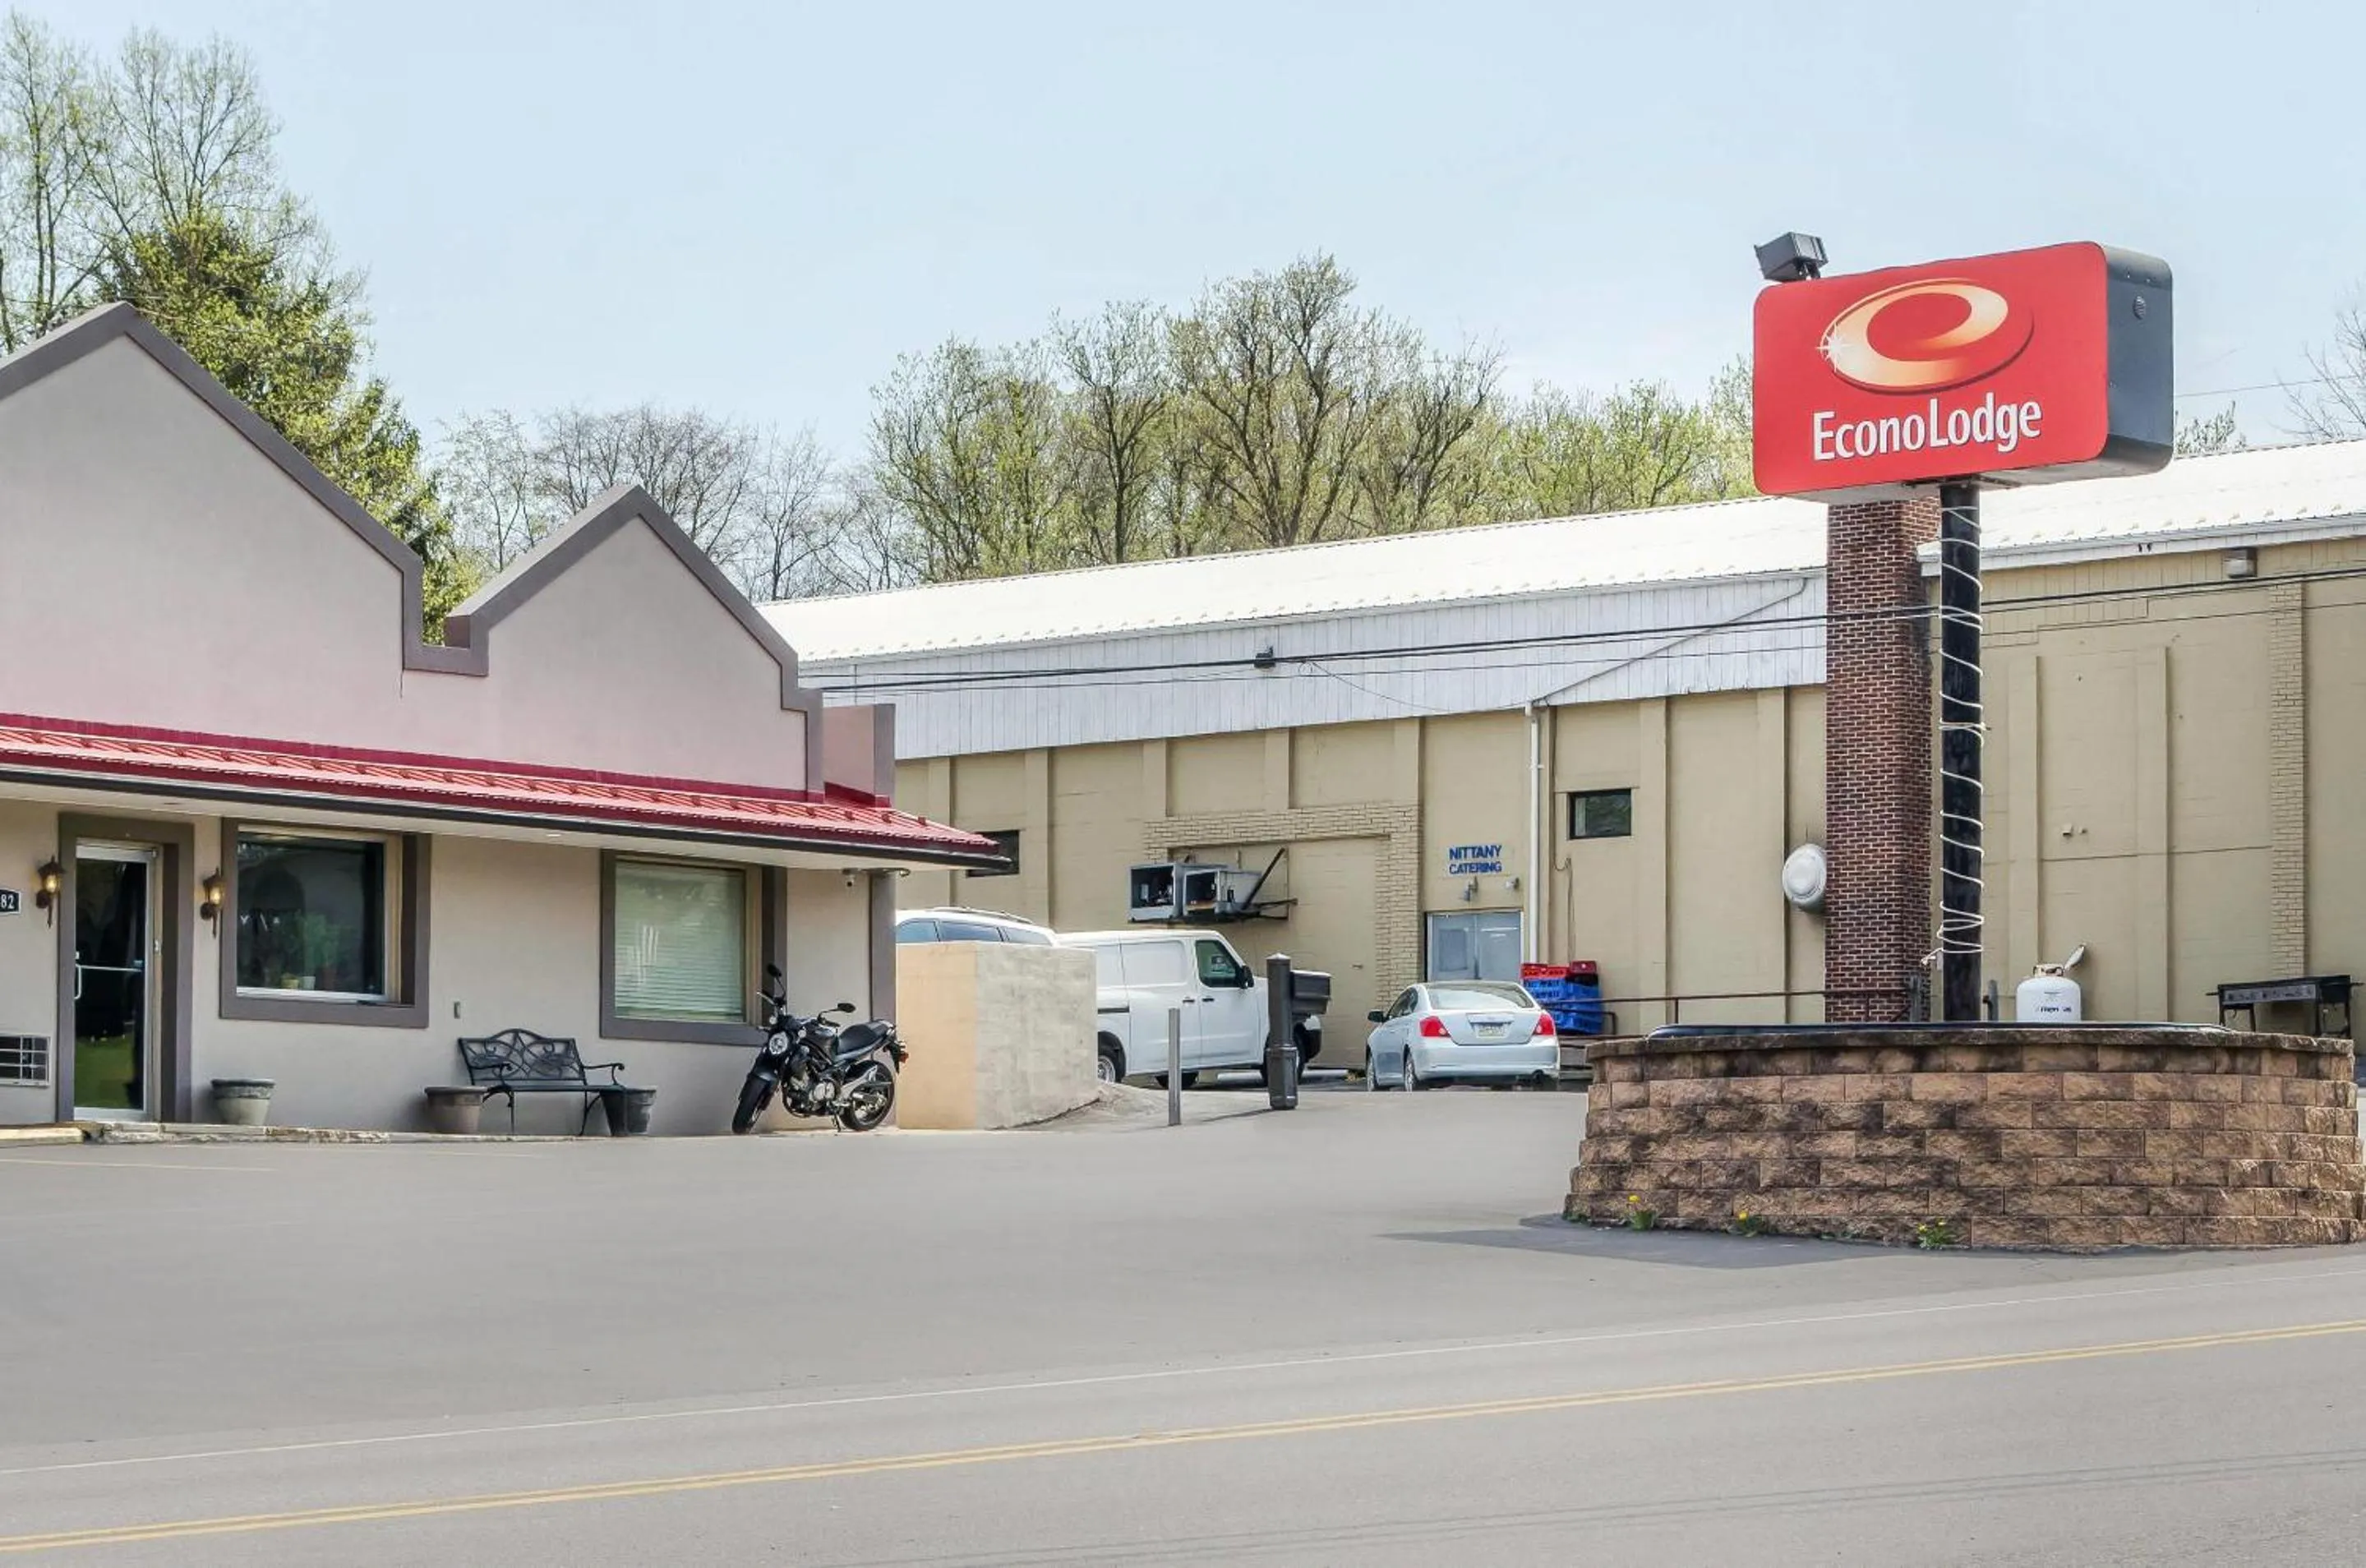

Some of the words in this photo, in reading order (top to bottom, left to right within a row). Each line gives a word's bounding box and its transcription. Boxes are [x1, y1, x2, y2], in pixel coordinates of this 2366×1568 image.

[1813, 392, 2042, 461] EconoLodge
[1449, 845, 1502, 860] NITTANY
[1449, 861, 1502, 875] CATERING
